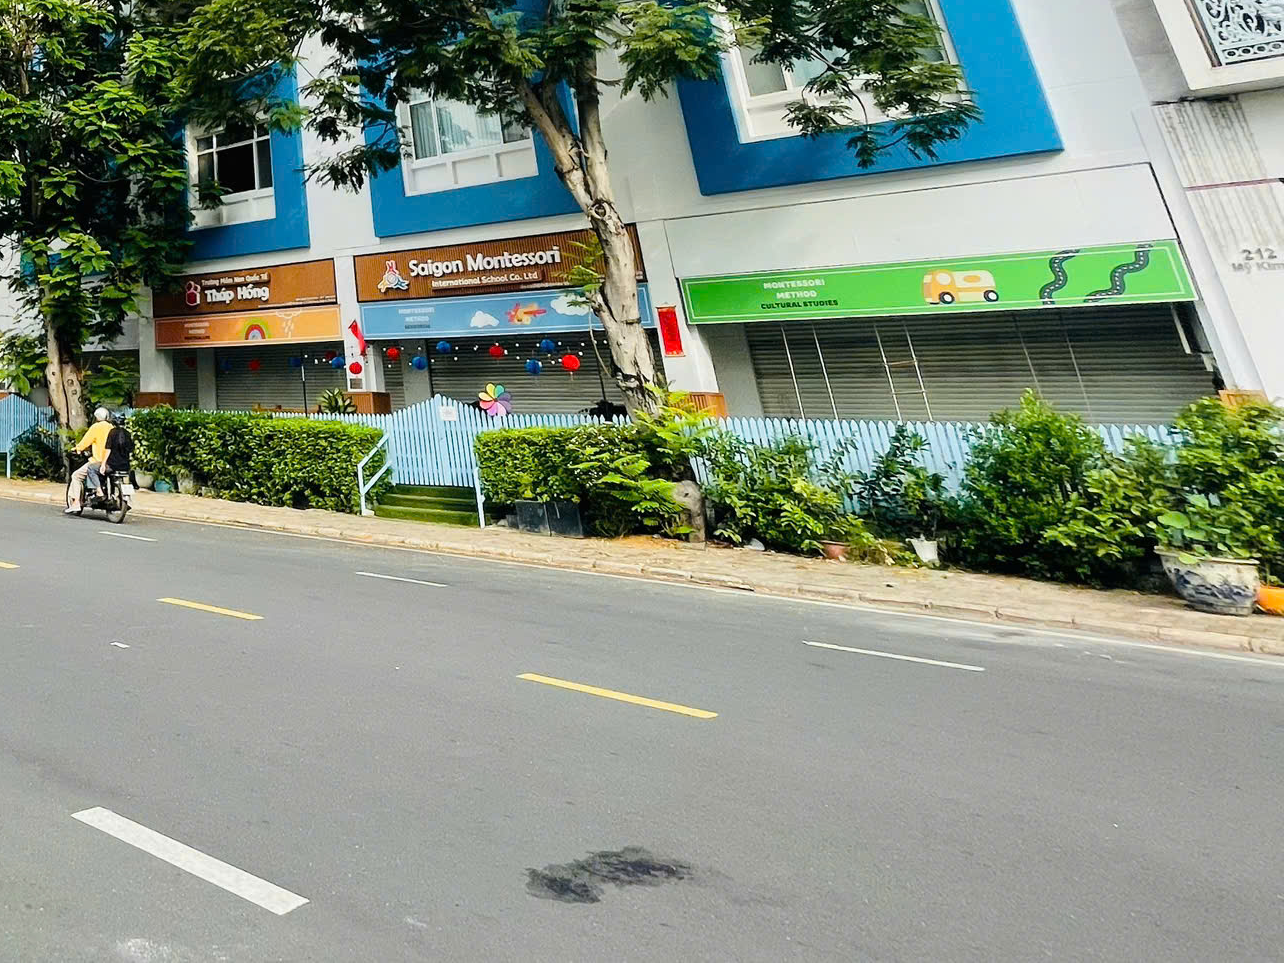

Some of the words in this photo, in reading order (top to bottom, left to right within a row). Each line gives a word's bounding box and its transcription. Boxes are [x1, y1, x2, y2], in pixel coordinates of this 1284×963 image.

[408, 259, 464, 278] Saigon
[466, 245, 561, 272] Montessori
[431, 276, 480, 288] International
[481, 273, 508, 284] School
[509, 272, 522, 281] Co.
[523, 271, 538, 280] Ltd
[763, 279, 825, 289] MONTESSORI
[205, 287, 235, 304] Tháp
[776, 290, 817, 300] METHOD
[761, 301, 802, 310] CULTURAL
[802, 299, 838, 308] STUDIES
